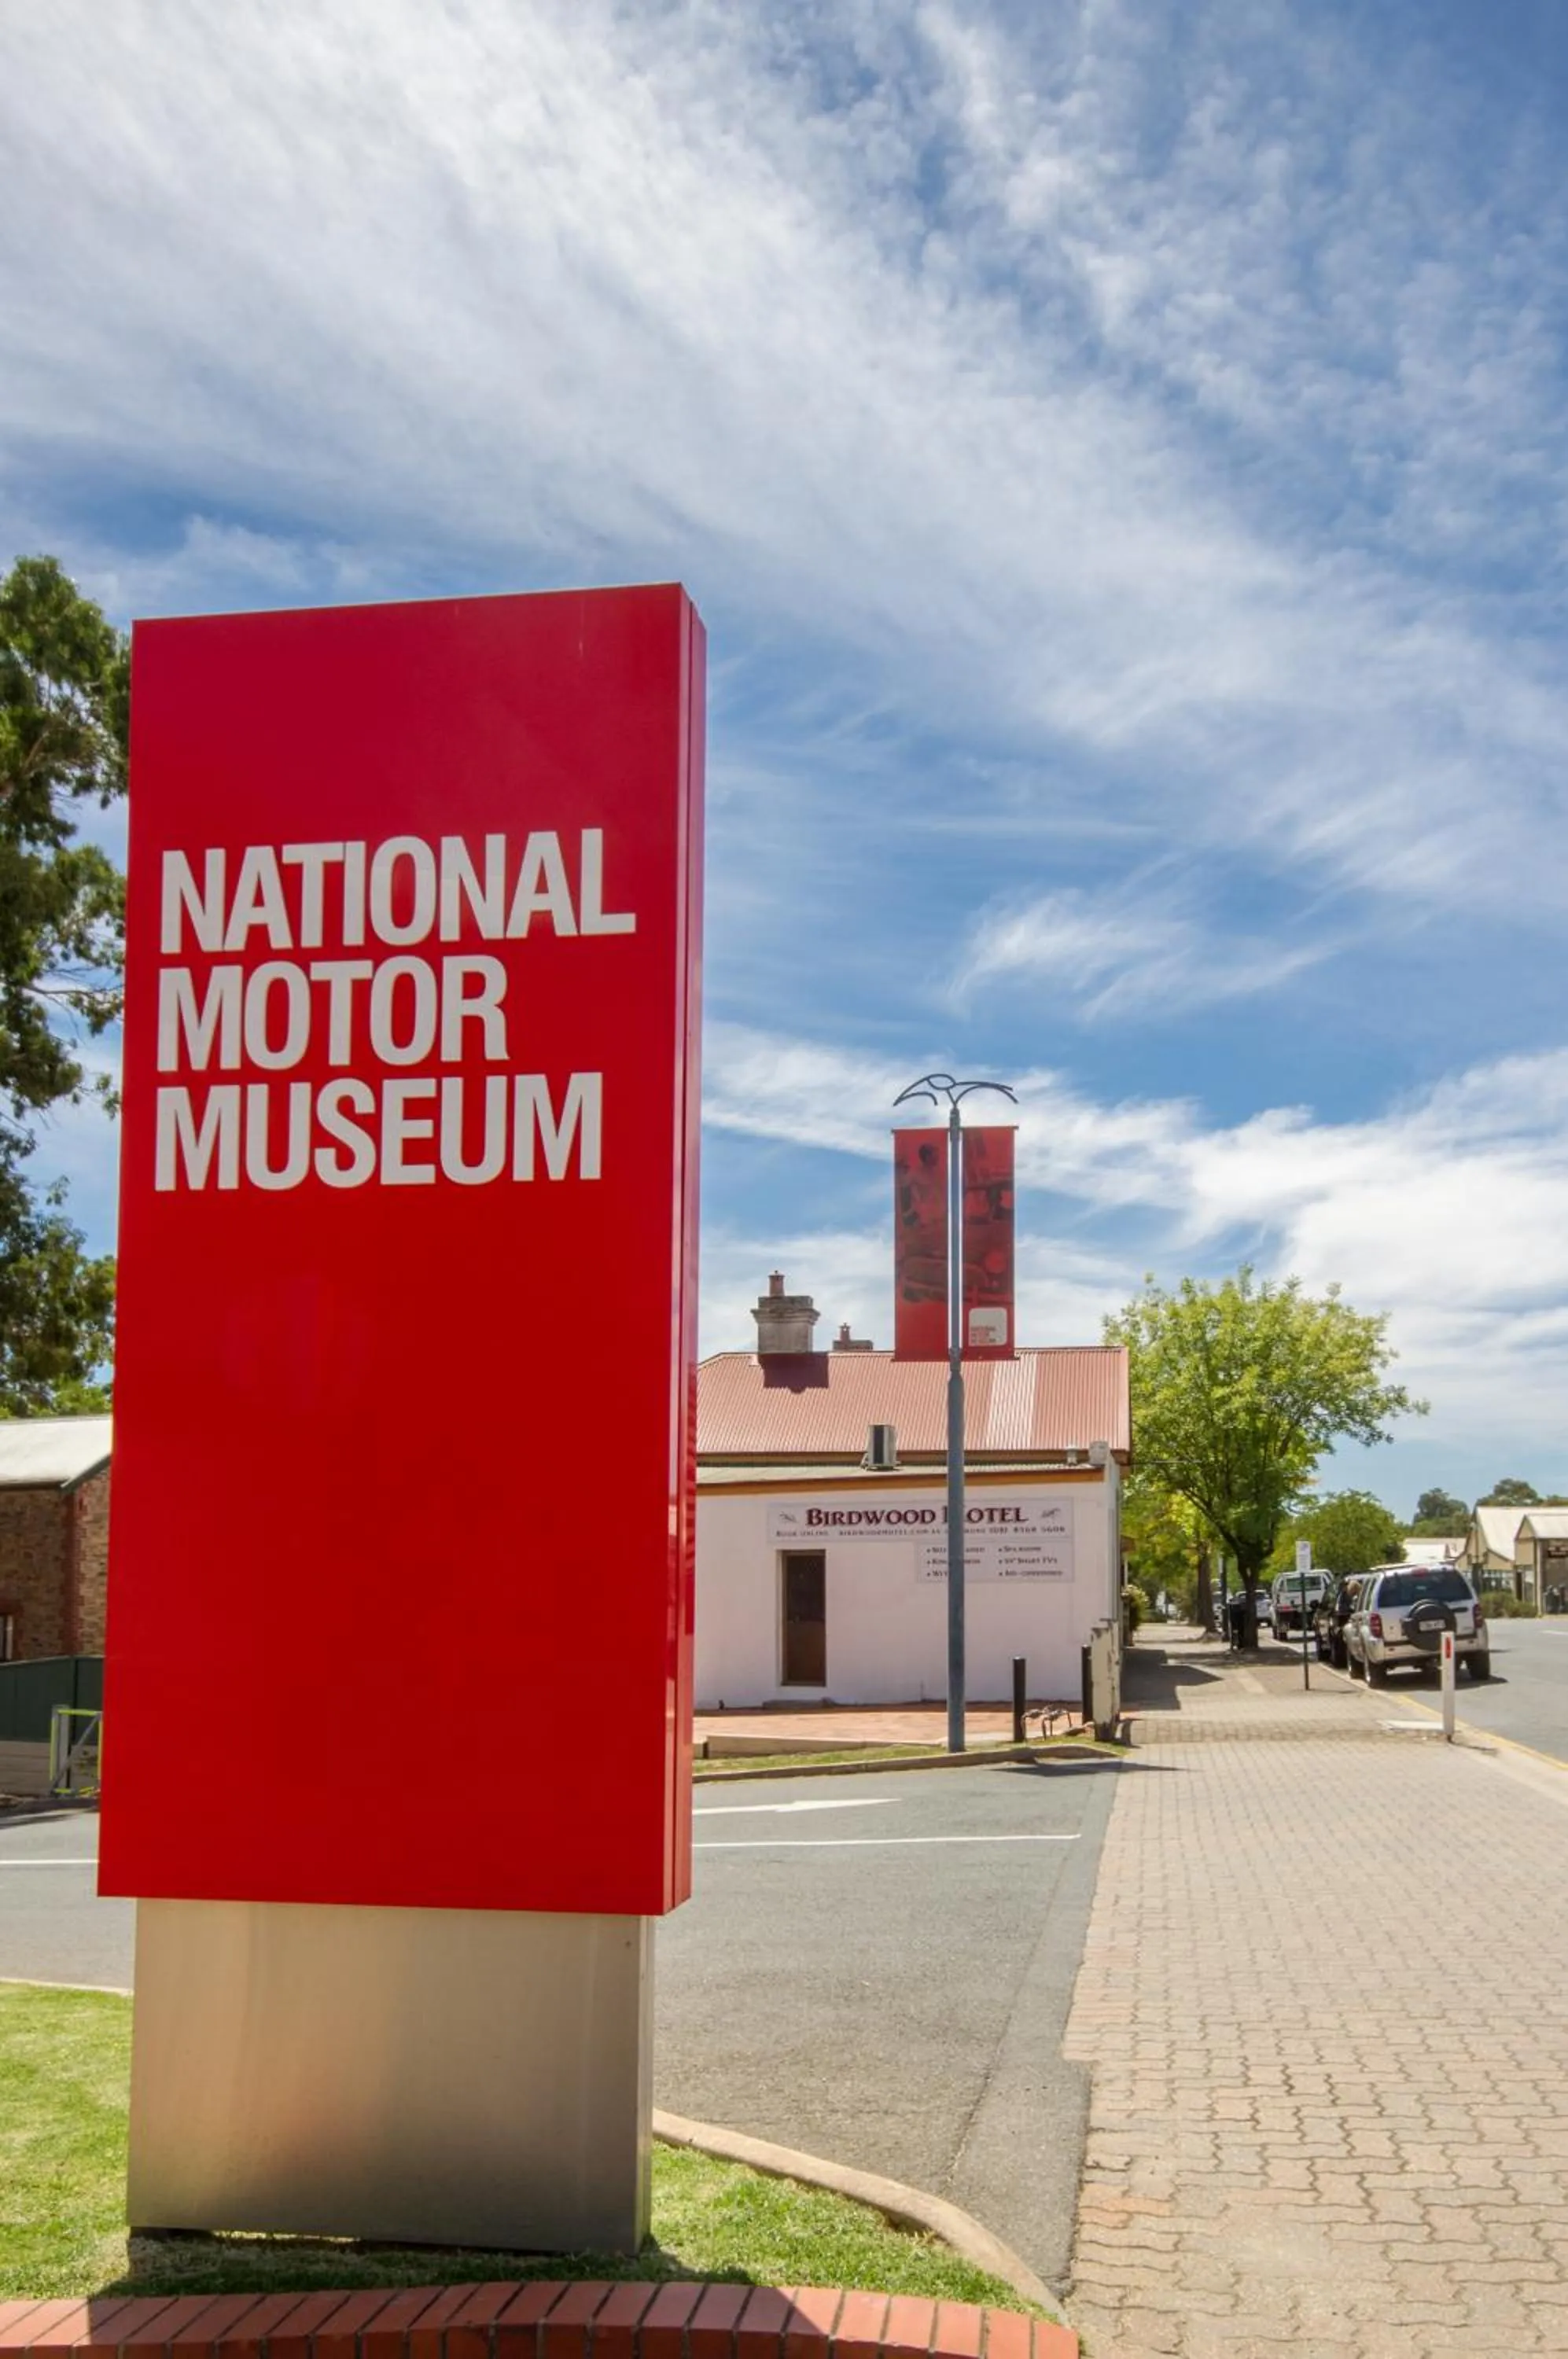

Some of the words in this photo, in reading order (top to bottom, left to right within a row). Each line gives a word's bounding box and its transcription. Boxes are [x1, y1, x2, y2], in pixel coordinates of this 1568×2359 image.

[160, 828, 636, 954] NATIONAL
[156, 955, 510, 1073] MOTOR
[155, 1072, 602, 1192] MUSEUM
[806, 1507, 937, 1526] BIRDWOOD
